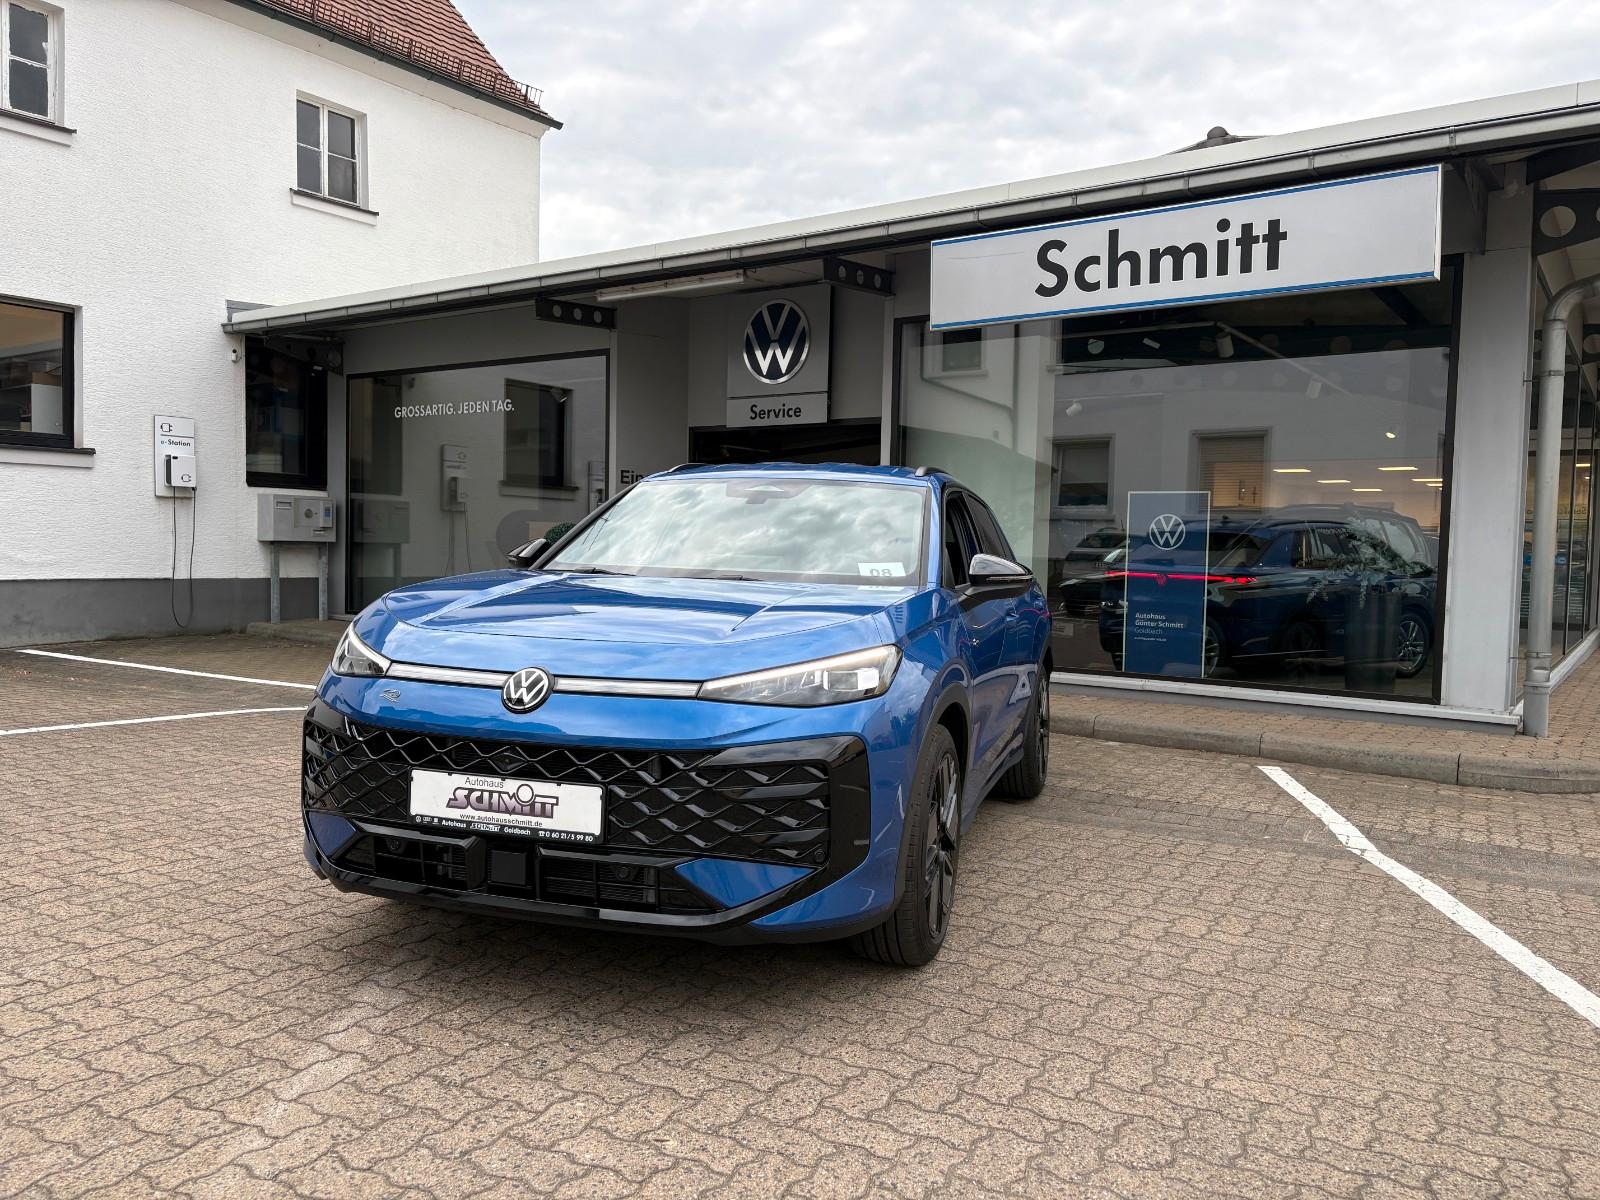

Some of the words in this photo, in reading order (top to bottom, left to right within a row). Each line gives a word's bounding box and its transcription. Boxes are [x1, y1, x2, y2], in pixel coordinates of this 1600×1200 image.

[1034, 217, 1288, 298] Schmitt
[394, 403, 456, 418] GROSSARTIG.
[458, 400, 490, 414] JEDEN
[491, 399, 515, 412] TAG.
[749, 403, 802, 420] Service
[1135, 612, 1166, 620] Autohaus
[1157, 621, 1184, 629] Schmitt
[464, 776, 504, 789] Autohaus
[441, 819, 467, 829] Autohaus
[504, 827, 531, 836] Goldbach
[459, 813, 543, 828] www.autohausschmitt.de
